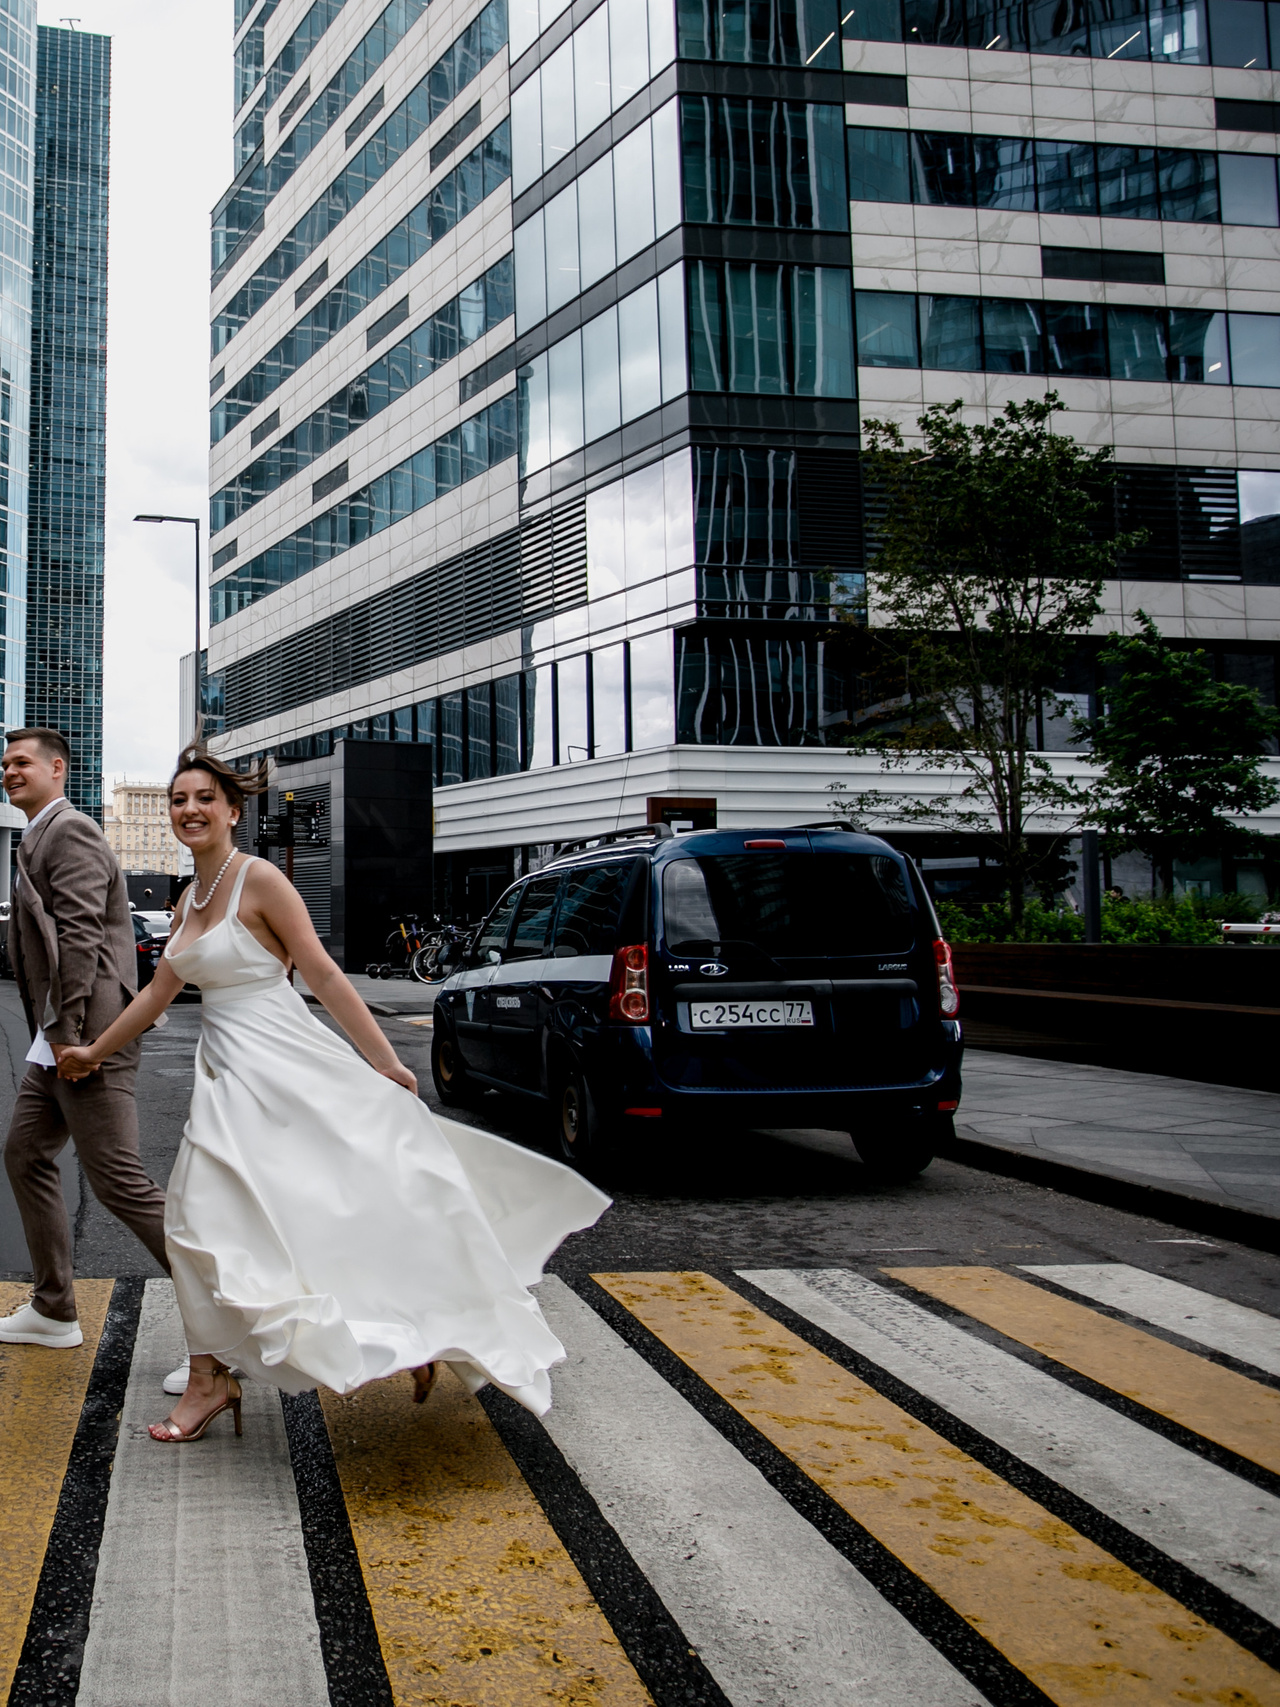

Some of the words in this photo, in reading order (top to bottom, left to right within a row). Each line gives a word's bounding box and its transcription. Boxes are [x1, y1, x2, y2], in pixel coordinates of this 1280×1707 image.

[668, 964, 690, 972] LADA
[877, 963, 908, 971] LARGUS
[785, 1003, 805, 1018] 77
